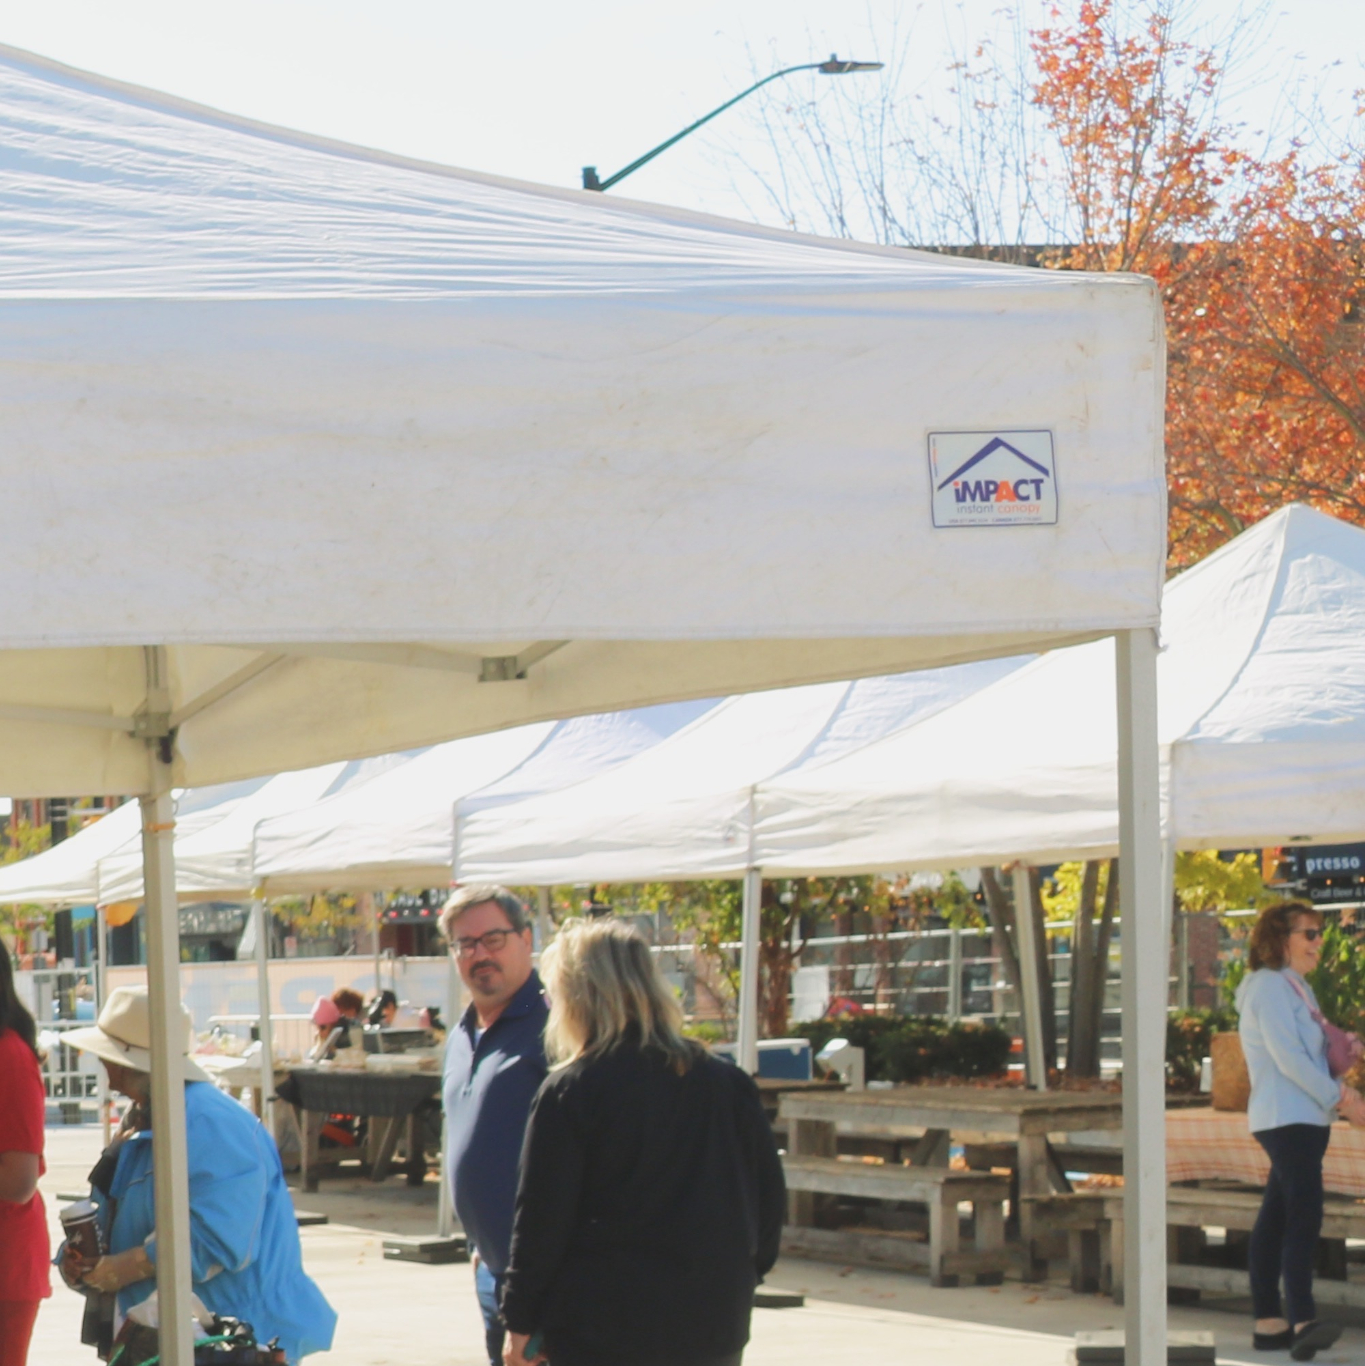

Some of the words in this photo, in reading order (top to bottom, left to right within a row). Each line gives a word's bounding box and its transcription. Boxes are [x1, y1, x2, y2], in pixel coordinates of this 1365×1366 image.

[957, 503, 994, 514] instant
[997, 503, 1041, 516] canopy
[1305, 856, 1361, 875] presso
